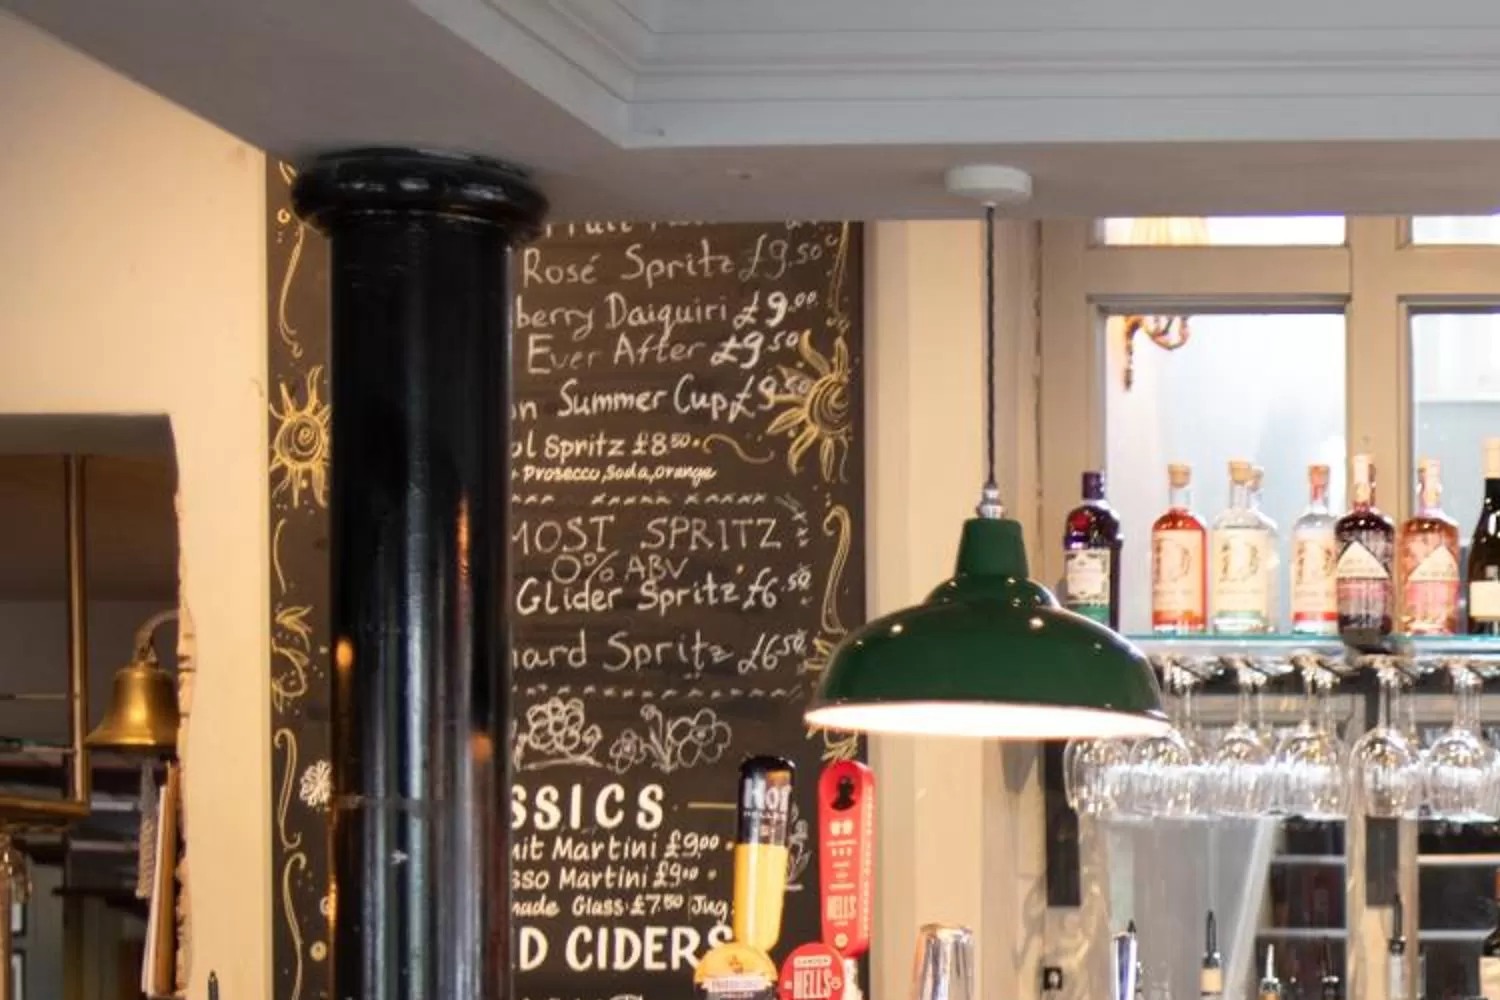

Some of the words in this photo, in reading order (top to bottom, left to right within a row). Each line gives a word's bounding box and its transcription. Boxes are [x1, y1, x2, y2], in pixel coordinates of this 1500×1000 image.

[523, 247, 602, 289] Rosé
[620, 237, 736, 289] Spritz
[515, 294, 594, 342] berry
[604, 291, 728, 342] Daiquiri
[527, 333, 602, 375] Ever
[613, 331, 707, 368] After
[556, 377, 669, 417] Summer
[673, 372, 729, 421] Cup
[543, 430, 626, 465] Spritz
[640, 516, 782, 551] SPRITZ
[624, 554, 689, 581] ABV
[636, 571, 741, 617] Spritz
[602, 629, 735, 673] Spritz
[551, 832, 658, 862] Martini
[558, 864, 649, 890] Martini
[794, 967, 833, 1000] HELLS
